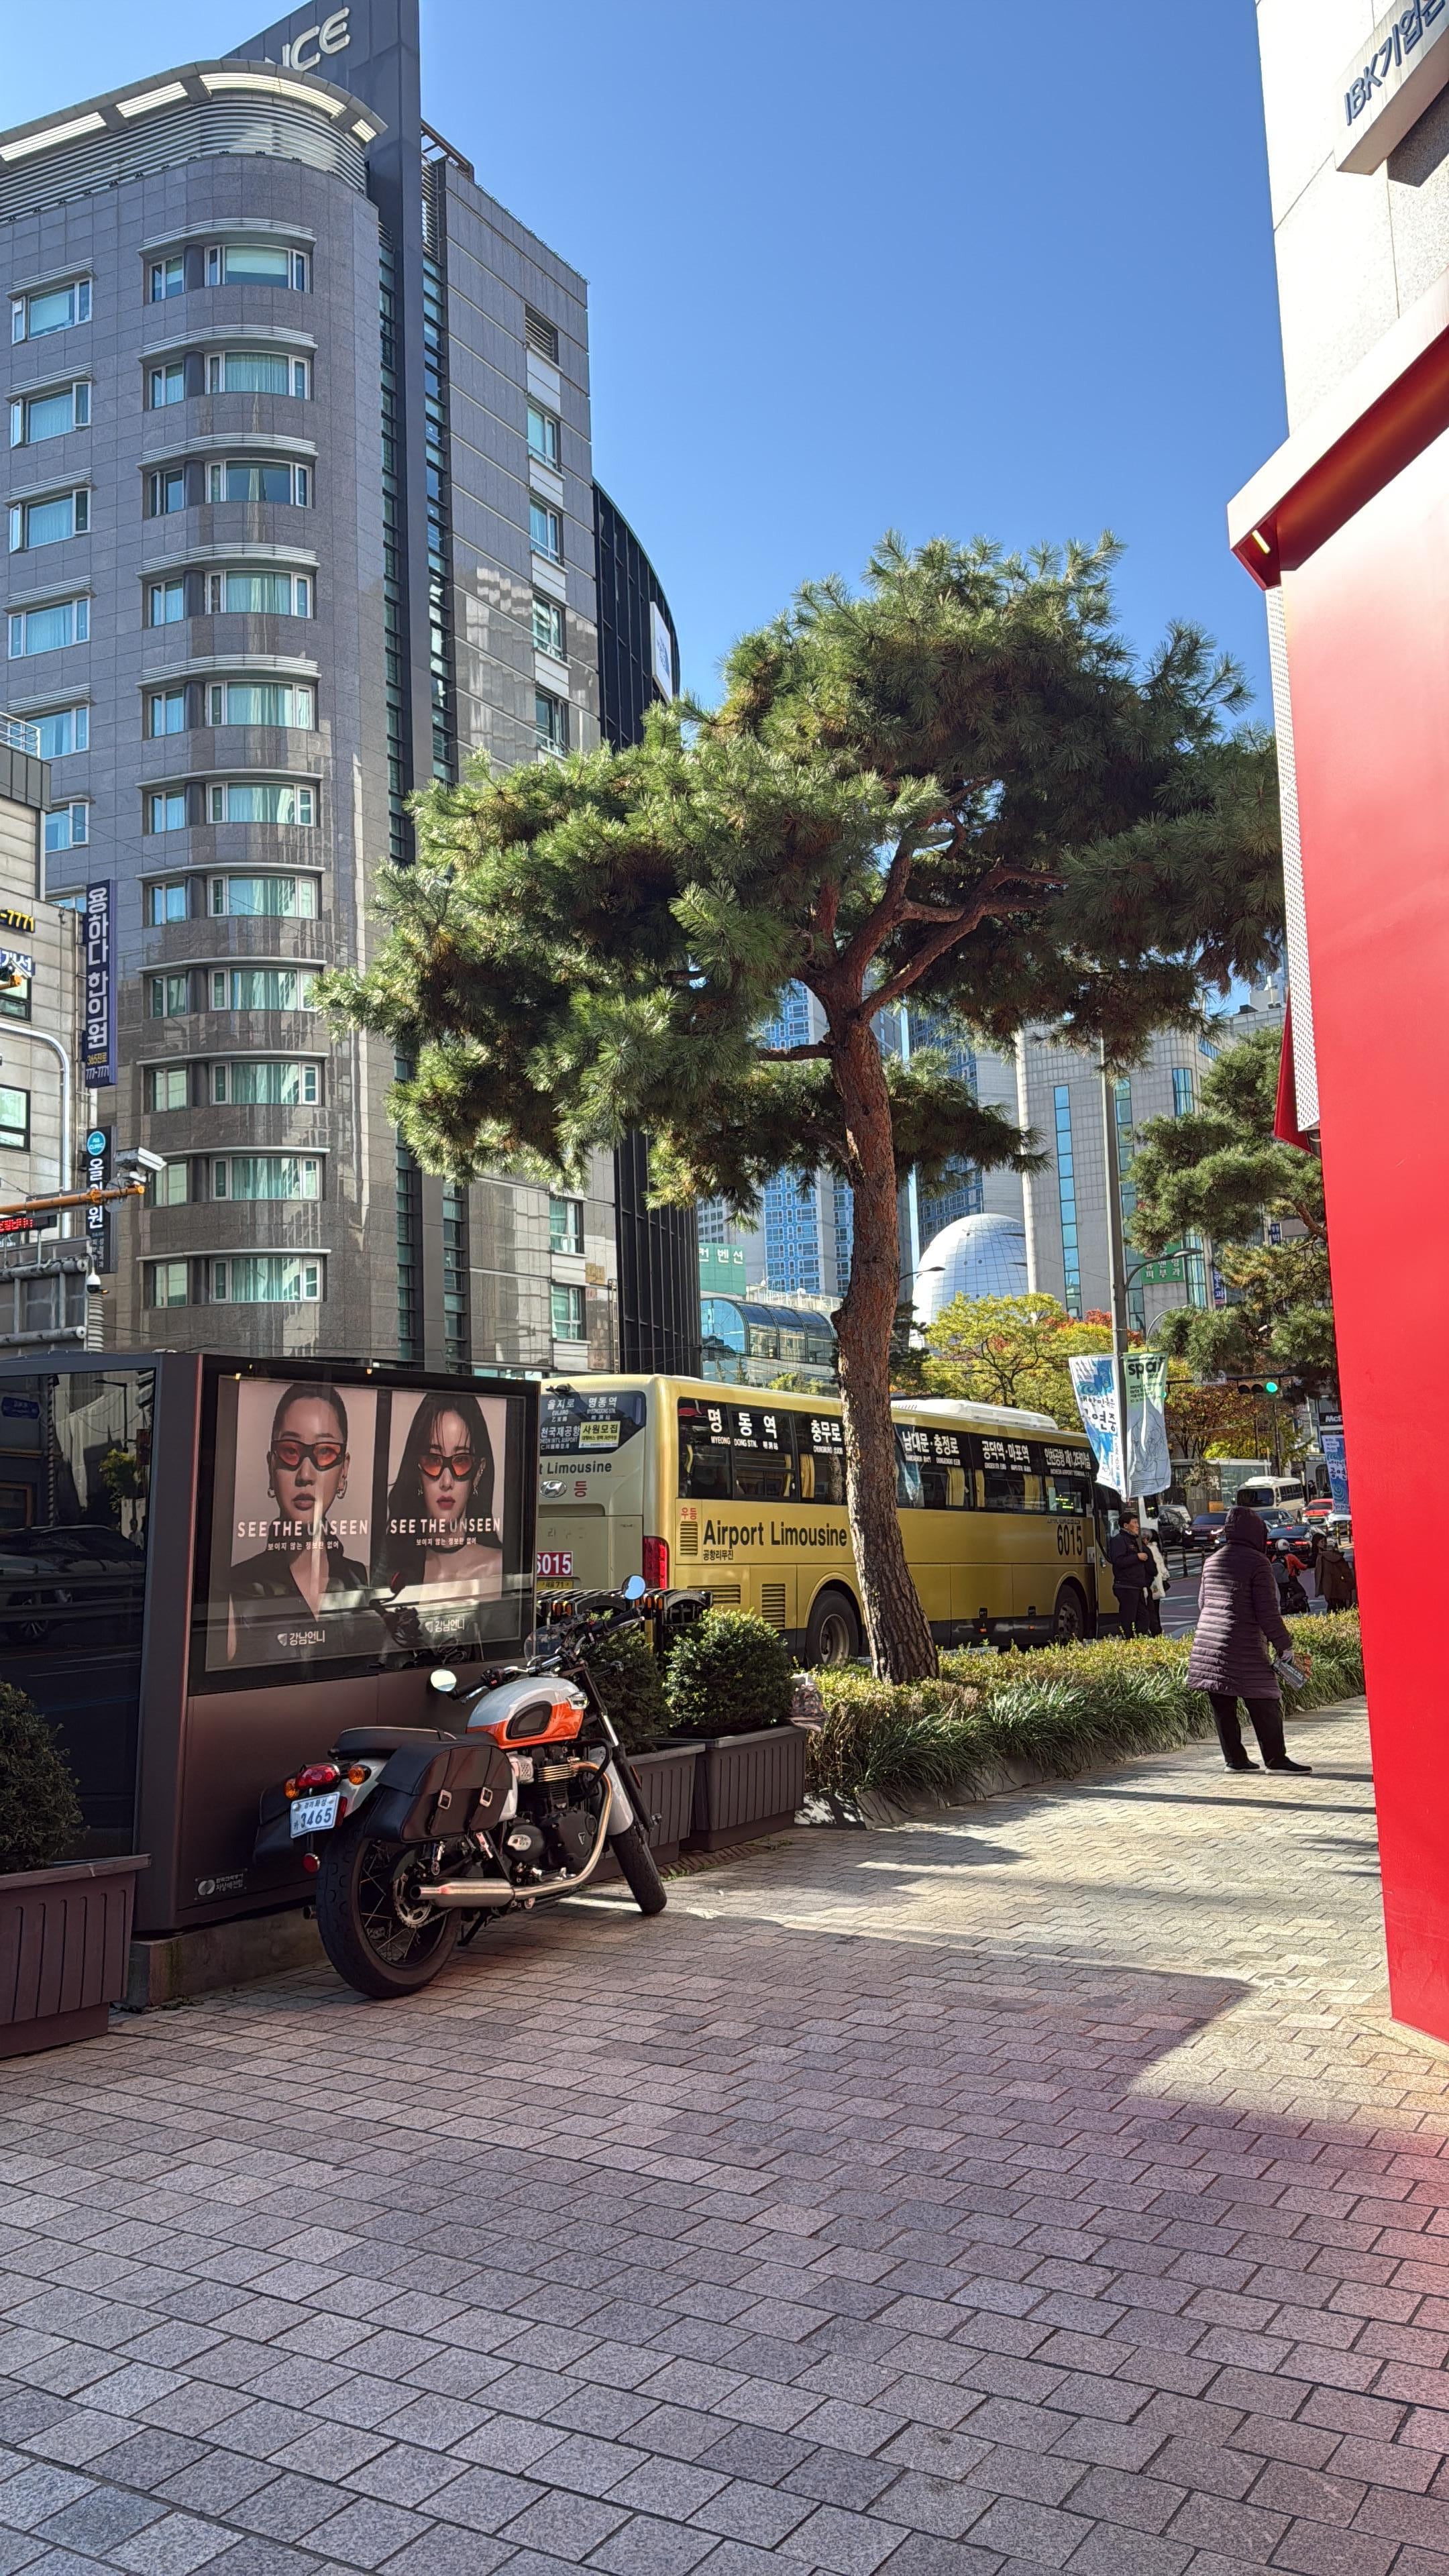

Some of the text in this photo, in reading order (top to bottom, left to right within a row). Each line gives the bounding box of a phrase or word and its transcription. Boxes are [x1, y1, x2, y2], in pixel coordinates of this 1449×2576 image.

[87, 886, 109, 1050] 용하다 한의원
[1145, 1269, 1181, 1280] 피부과
[547, 1397, 617, 1410] 을지로 명동역
[541, 1425, 580, 1438] 천국제공항
[582, 1424, 618, 1434] 사원모집
[810, 1419, 842, 1443] 충무로
[547, 1460, 612, 1474] Limousine
[574, 1481, 588, 1498] 등
[681, 1507, 697, 1520] 우등
[237, 1519, 368, 1538] SEE THE UNSEEN
[390, 1517, 500, 1534] SEE THE UNSEEN
[703, 1519, 847, 1549] Airport Limousine
[1057, 1524, 1083, 1556] 6015
[268, 1542, 286, 1550] 보이지
[702, 1550, 734, 1561] 공항리무진
[435, 1618, 465, 1632] 강남언니
[289, 1630, 325, 1646] 강남언니
[301, 1807, 332, 1829] 3465
